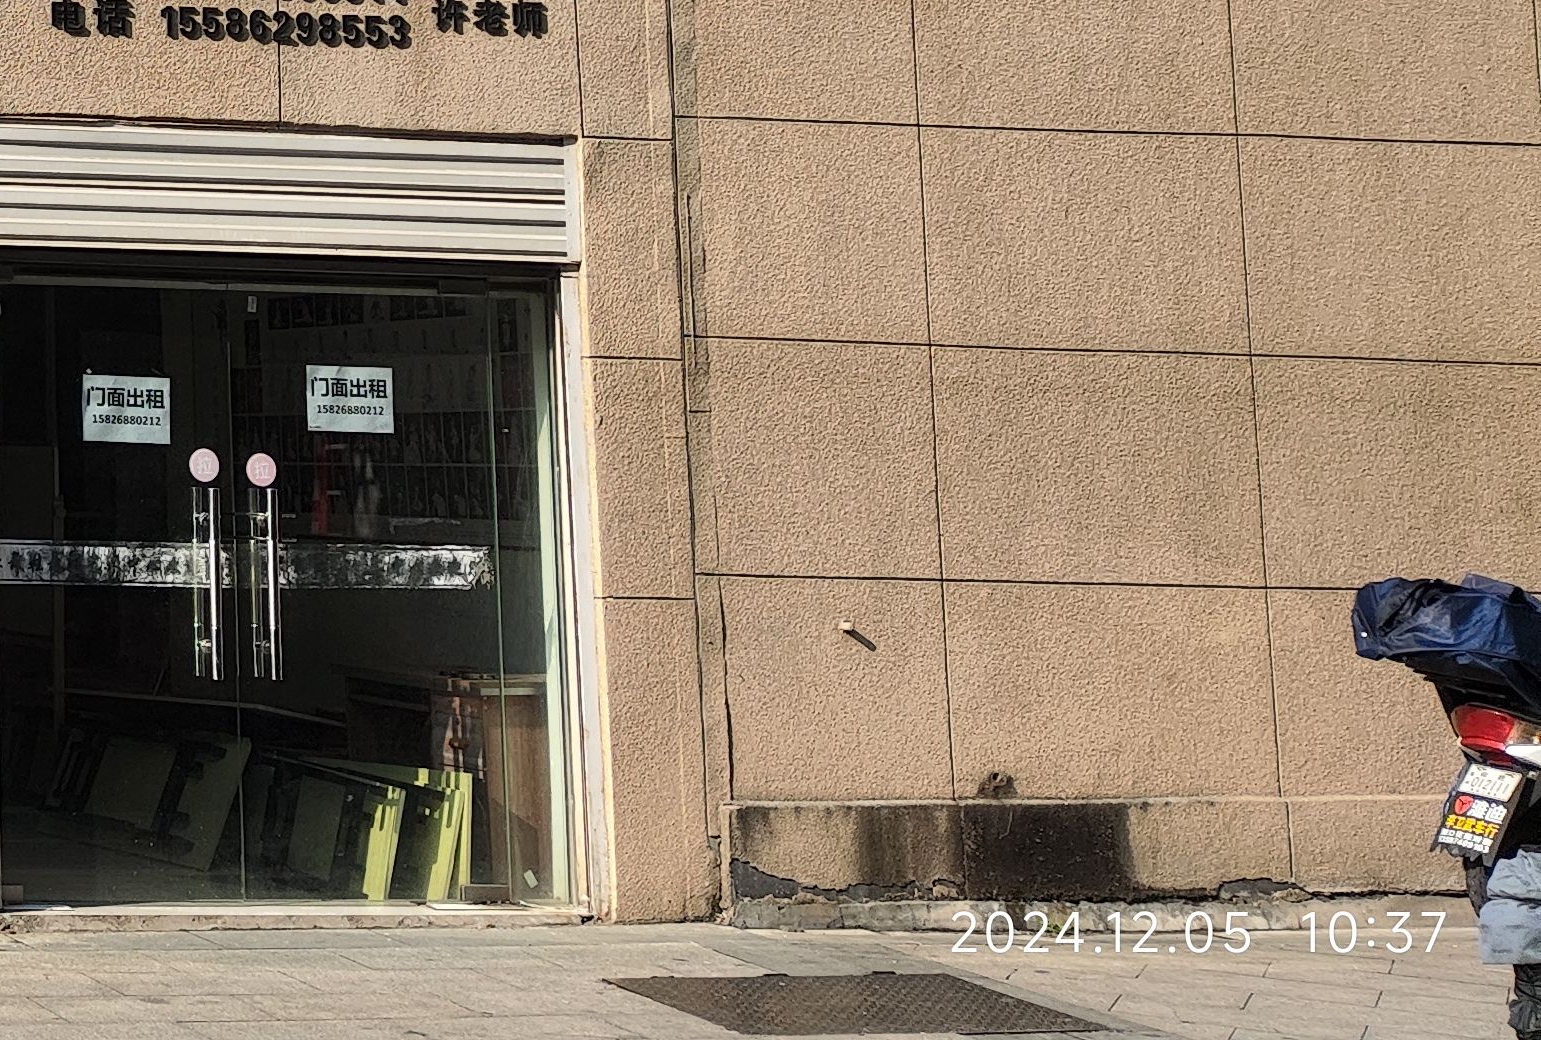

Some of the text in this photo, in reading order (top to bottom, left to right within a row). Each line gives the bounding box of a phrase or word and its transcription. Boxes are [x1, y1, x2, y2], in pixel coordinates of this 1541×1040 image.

[160, 4, 413, 50] 15586298553
[86, 385, 166, 410] 门面出租
[310, 376, 389, 400] 门面出租
[92, 413, 162, 427] 15826880212
[316, 404, 385, 416] 15826880212
[1466, 799, 1508, 825] 雅迪
